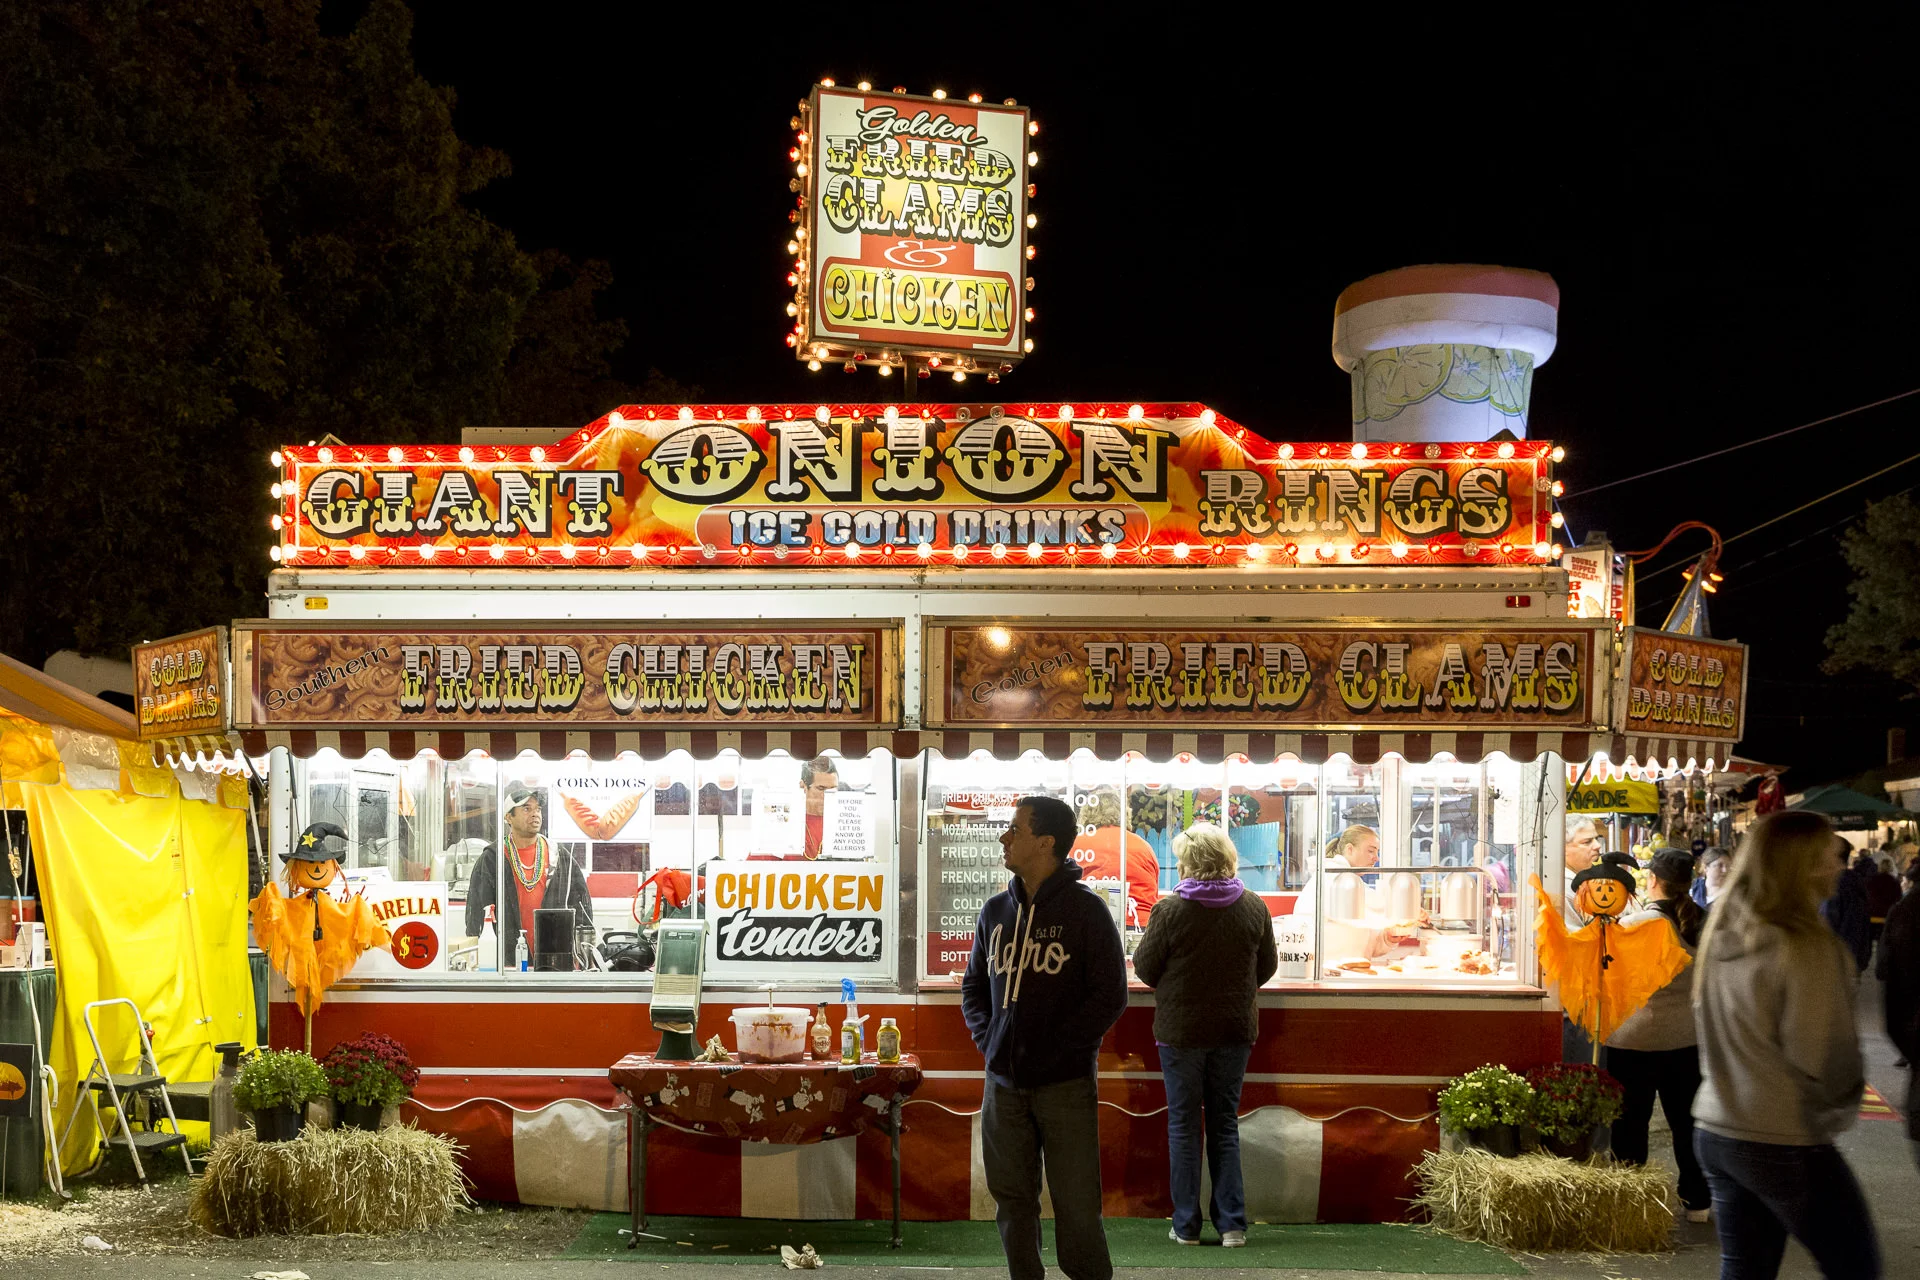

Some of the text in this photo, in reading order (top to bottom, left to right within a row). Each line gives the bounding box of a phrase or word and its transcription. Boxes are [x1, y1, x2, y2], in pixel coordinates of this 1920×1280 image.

[856, 106, 988, 145] Golden
[826, 135, 1016, 185] FRIED
[823, 174, 1015, 248] CLAMS
[884, 240, 957, 268] &
[301, 415, 1514, 539] GIANT ONION RINGS
[729, 510, 1126, 546] ICE COLD DRINKS
[1571, 557, 1598, 568] DOUBLE
[151, 649, 204, 688] COLD
[265, 643, 865, 715] Southern FRIED CHICKEN
[971, 640, 1580, 714] Golden FRIED CLAMS
[1650, 648, 1724, 688] COLD
[142, 685, 218, 726] DRINKS
[1630, 687, 1735, 729] DRINKS
[557, 778, 646, 788] CORN DOGS
[941, 793, 969, 802] FRIED
[972, 793, 1014, 802] CHICKEN
[1567, 790, 1630, 810] NADE
[941, 847, 1005, 858] FRIED CLA
[715, 873, 884, 912] CHICKEN
[941, 871, 1012, 883] FRENCH FRI
[371, 898, 441, 921] ARELLA
[953, 898, 983, 910] COLD
[719, 907, 881, 957] tenders
[940, 916, 976, 927] COKE,
[940, 930, 975, 941] SPRIT
[399, 934, 429, 959] $5
[940, 951, 971, 963] BOTT
